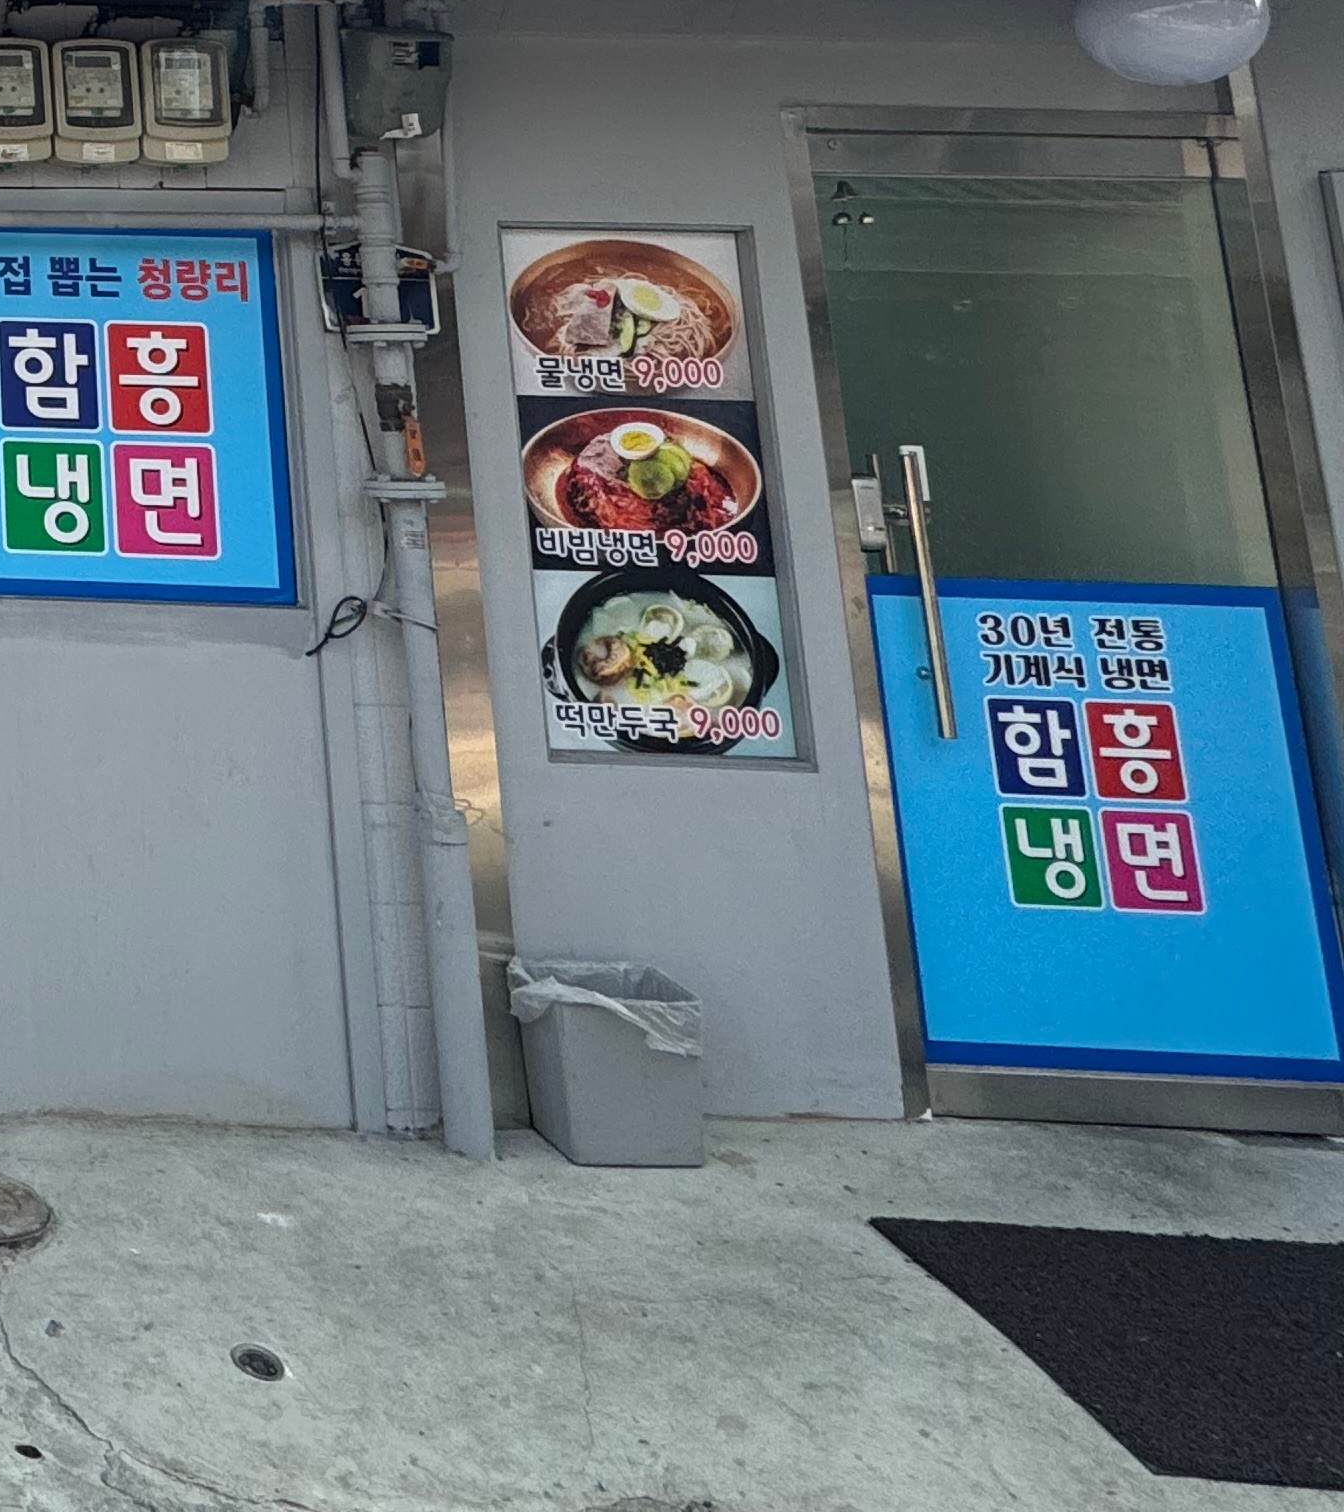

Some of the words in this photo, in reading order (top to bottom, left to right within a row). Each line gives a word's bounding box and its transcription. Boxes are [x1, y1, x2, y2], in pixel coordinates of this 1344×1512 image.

[47, 256, 122, 298] 뽑는
[137, 257, 249, 302] 청량리
[8, 328, 200, 426] 함흥
[535, 355, 626, 391] 물냉면
[632, 356, 724, 392] 9,000
[15, 453, 203, 546] 냉면
[536, 528, 658, 566] 비빔냉면
[663, 529, 758, 567] 9,000
[977, 613, 1074, 650] 30년
[1090, 615, 1168, 652] 전통
[981, 652, 1087, 690] 기계식
[1100, 656, 1173, 692] 냉면
[555, 703, 679, 742] 떡만두국
[688, 705, 782, 742] 9,000
[997, 704, 1172, 794] 함흥
[1014, 816, 1190, 902] 냉면
